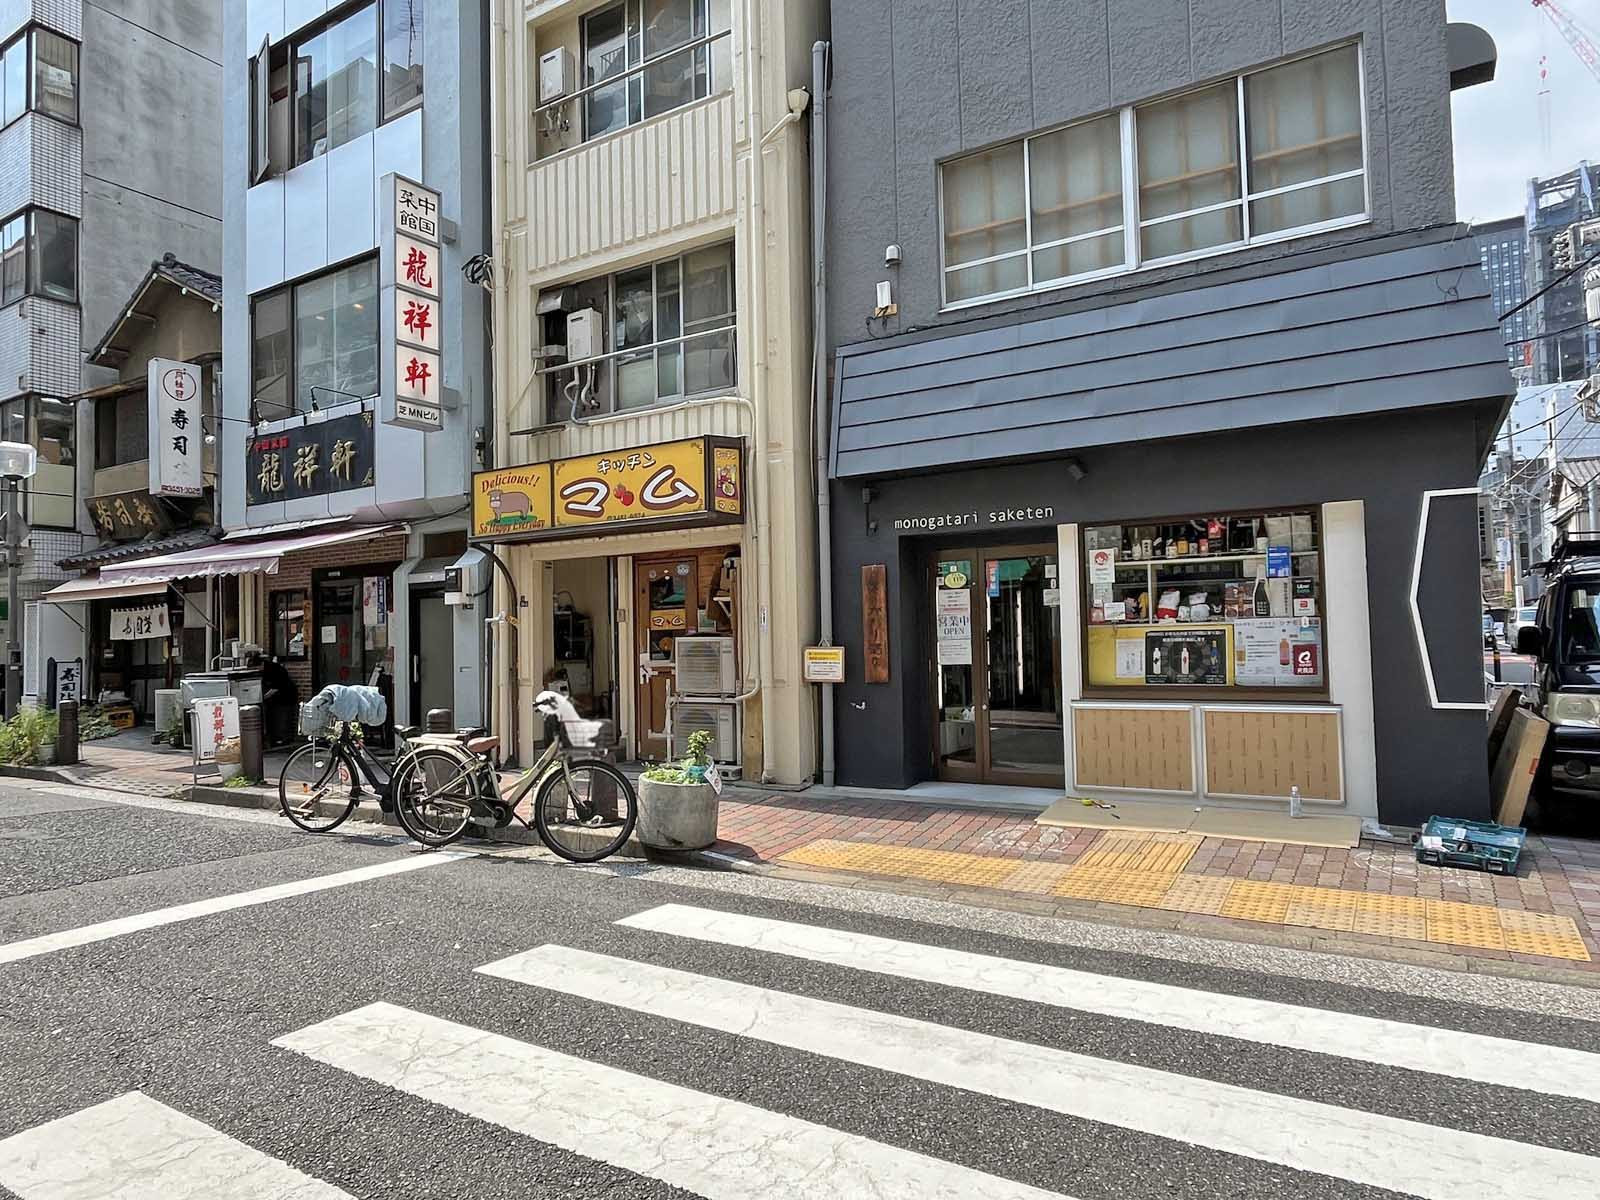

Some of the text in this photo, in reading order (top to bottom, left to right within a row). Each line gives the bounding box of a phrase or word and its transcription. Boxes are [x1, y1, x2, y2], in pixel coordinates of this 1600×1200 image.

[418, 197, 436, 236] 中国
[402, 246, 433, 396] 龍祥軒
[257, 439, 357, 496] 龍祥軒
[597, 452, 657, 475] キッチン
[481, 471, 540, 493] Delicious!!
[893, 506, 1054, 531] monogatari saketen
